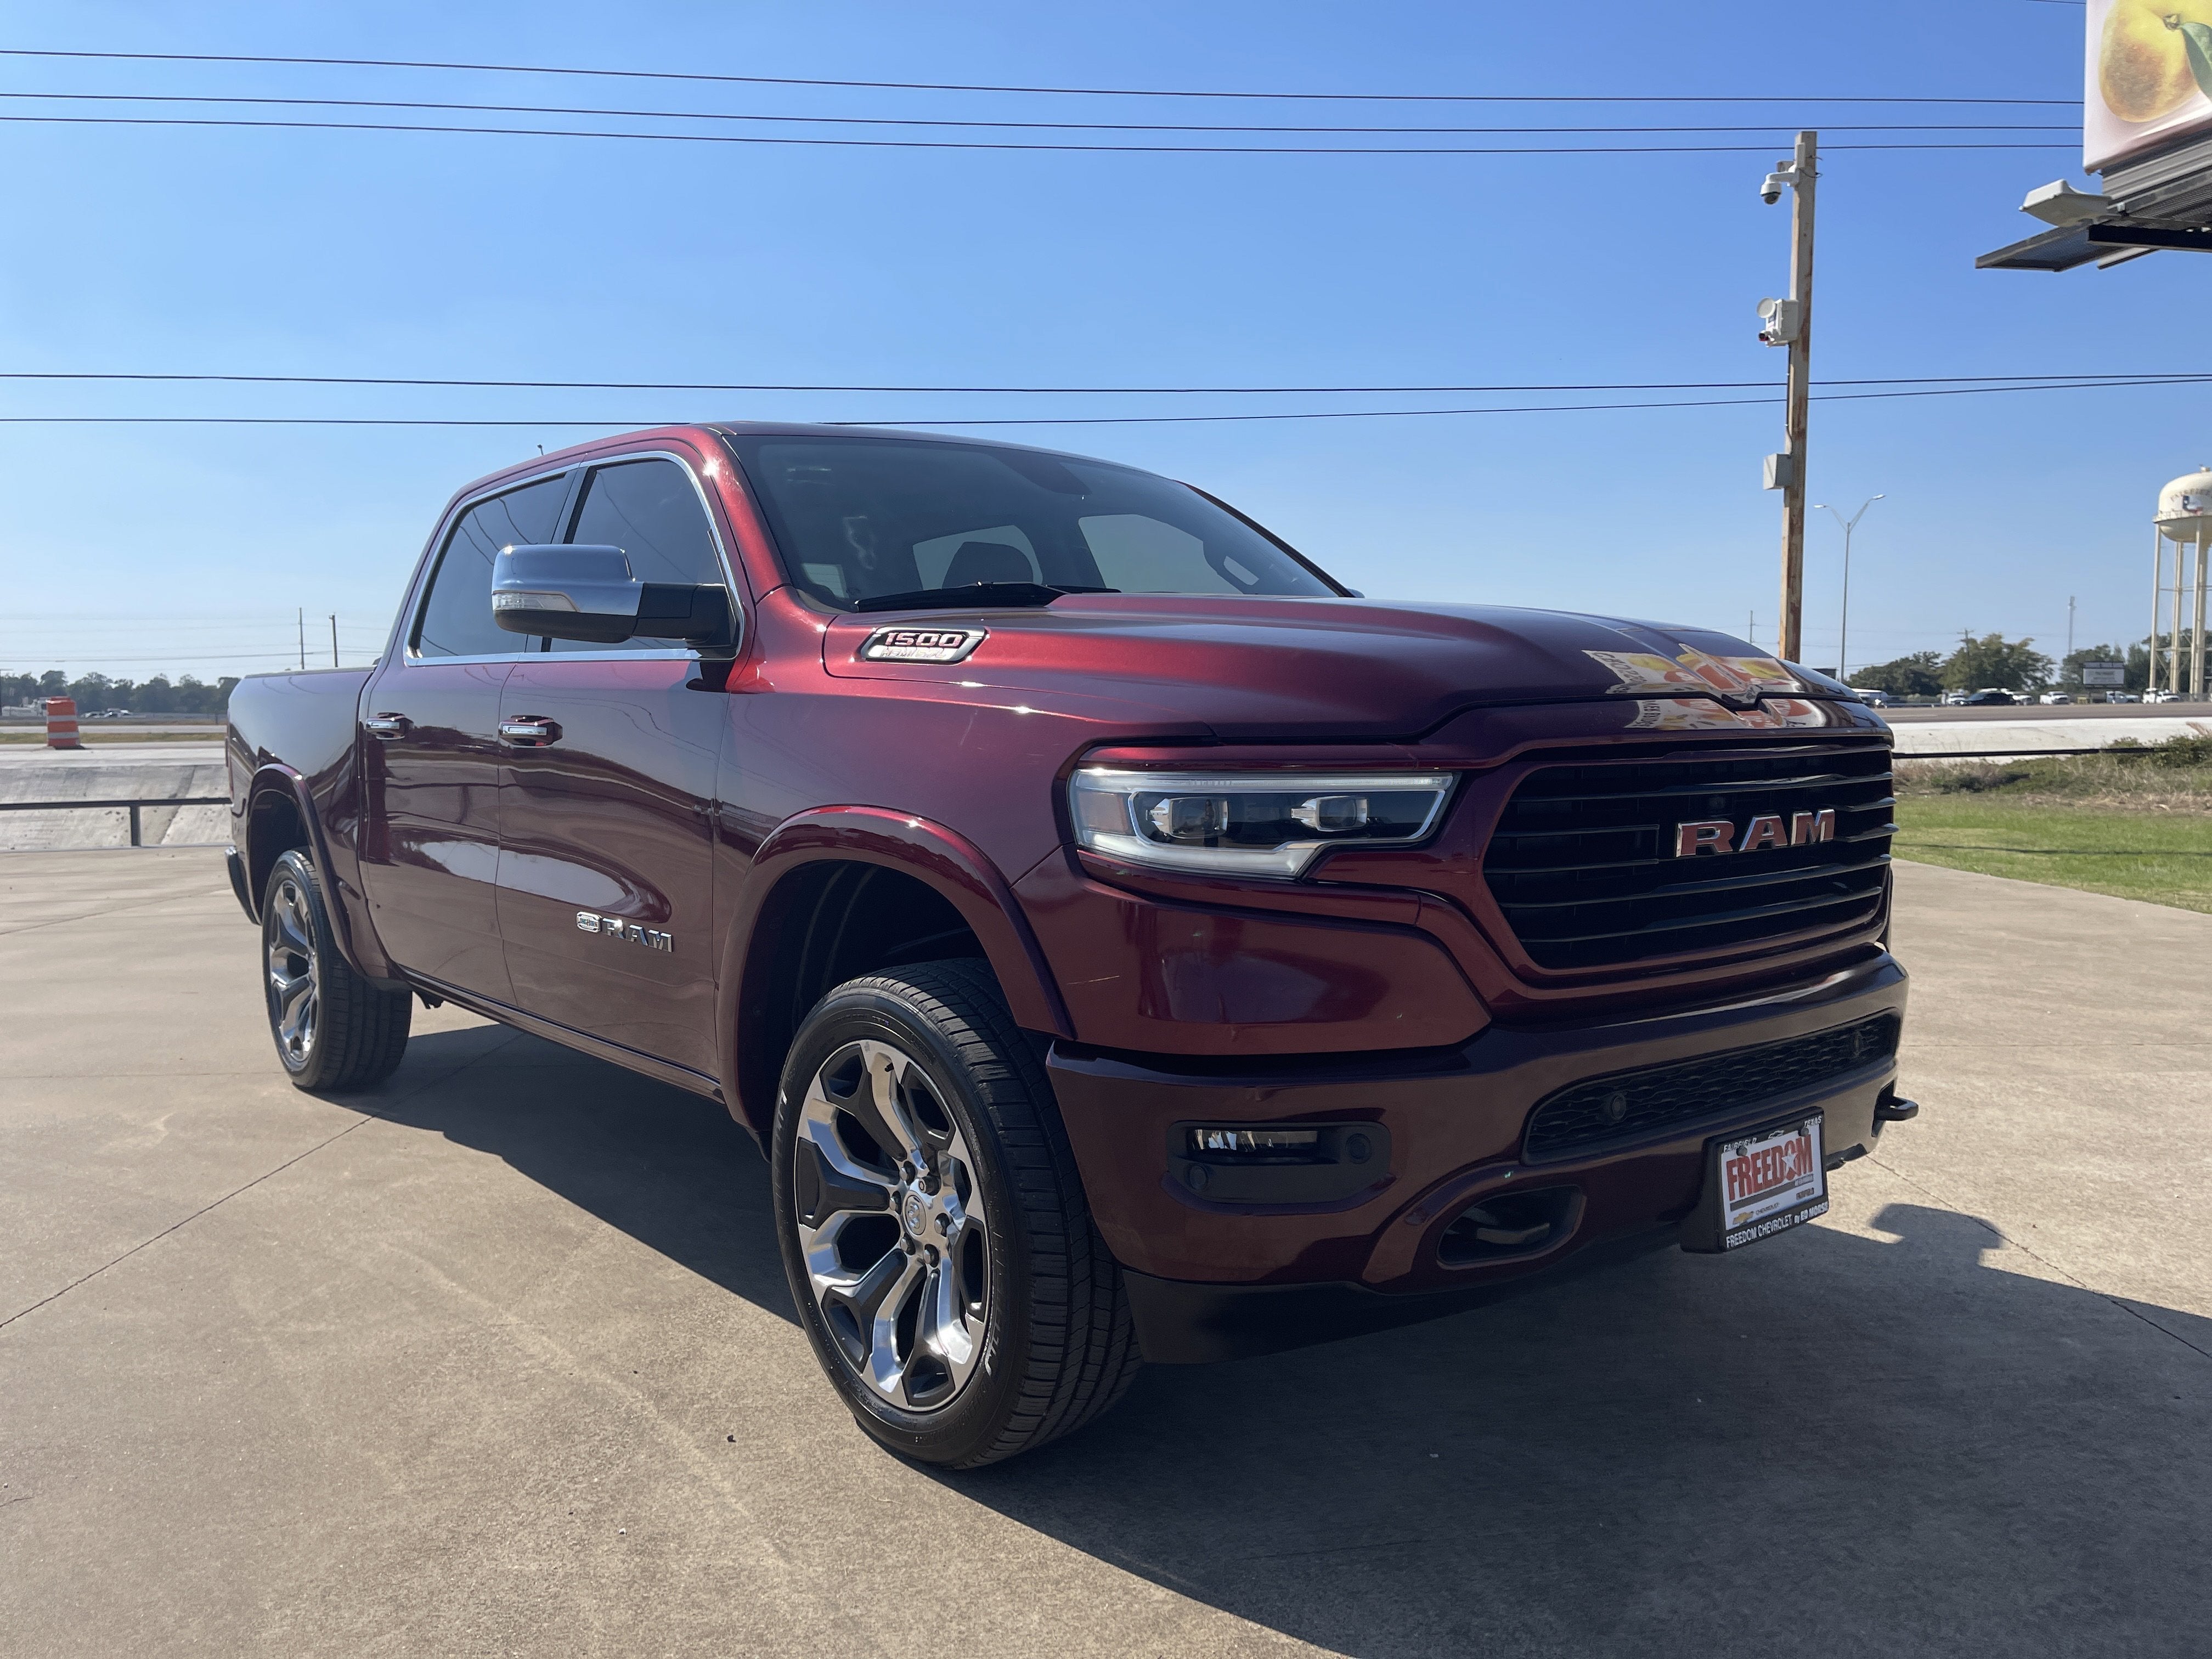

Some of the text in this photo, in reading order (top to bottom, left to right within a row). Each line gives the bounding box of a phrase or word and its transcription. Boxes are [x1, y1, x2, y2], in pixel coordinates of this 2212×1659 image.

[880, 648, 915, 657] HEMI
[884, 632, 966, 647] 1500
[1675, 809, 1835, 858] RAM
[602, 918, 673, 952] RAM
[1724, 1115, 1822, 1153] FAIRFIELD TEXAS
[1726, 1135, 1813, 1201] FREEDOM
[1726, 1227, 1757, 1249] FREEDOM
[1758, 1214, 1792, 1238] CHEVROLET
